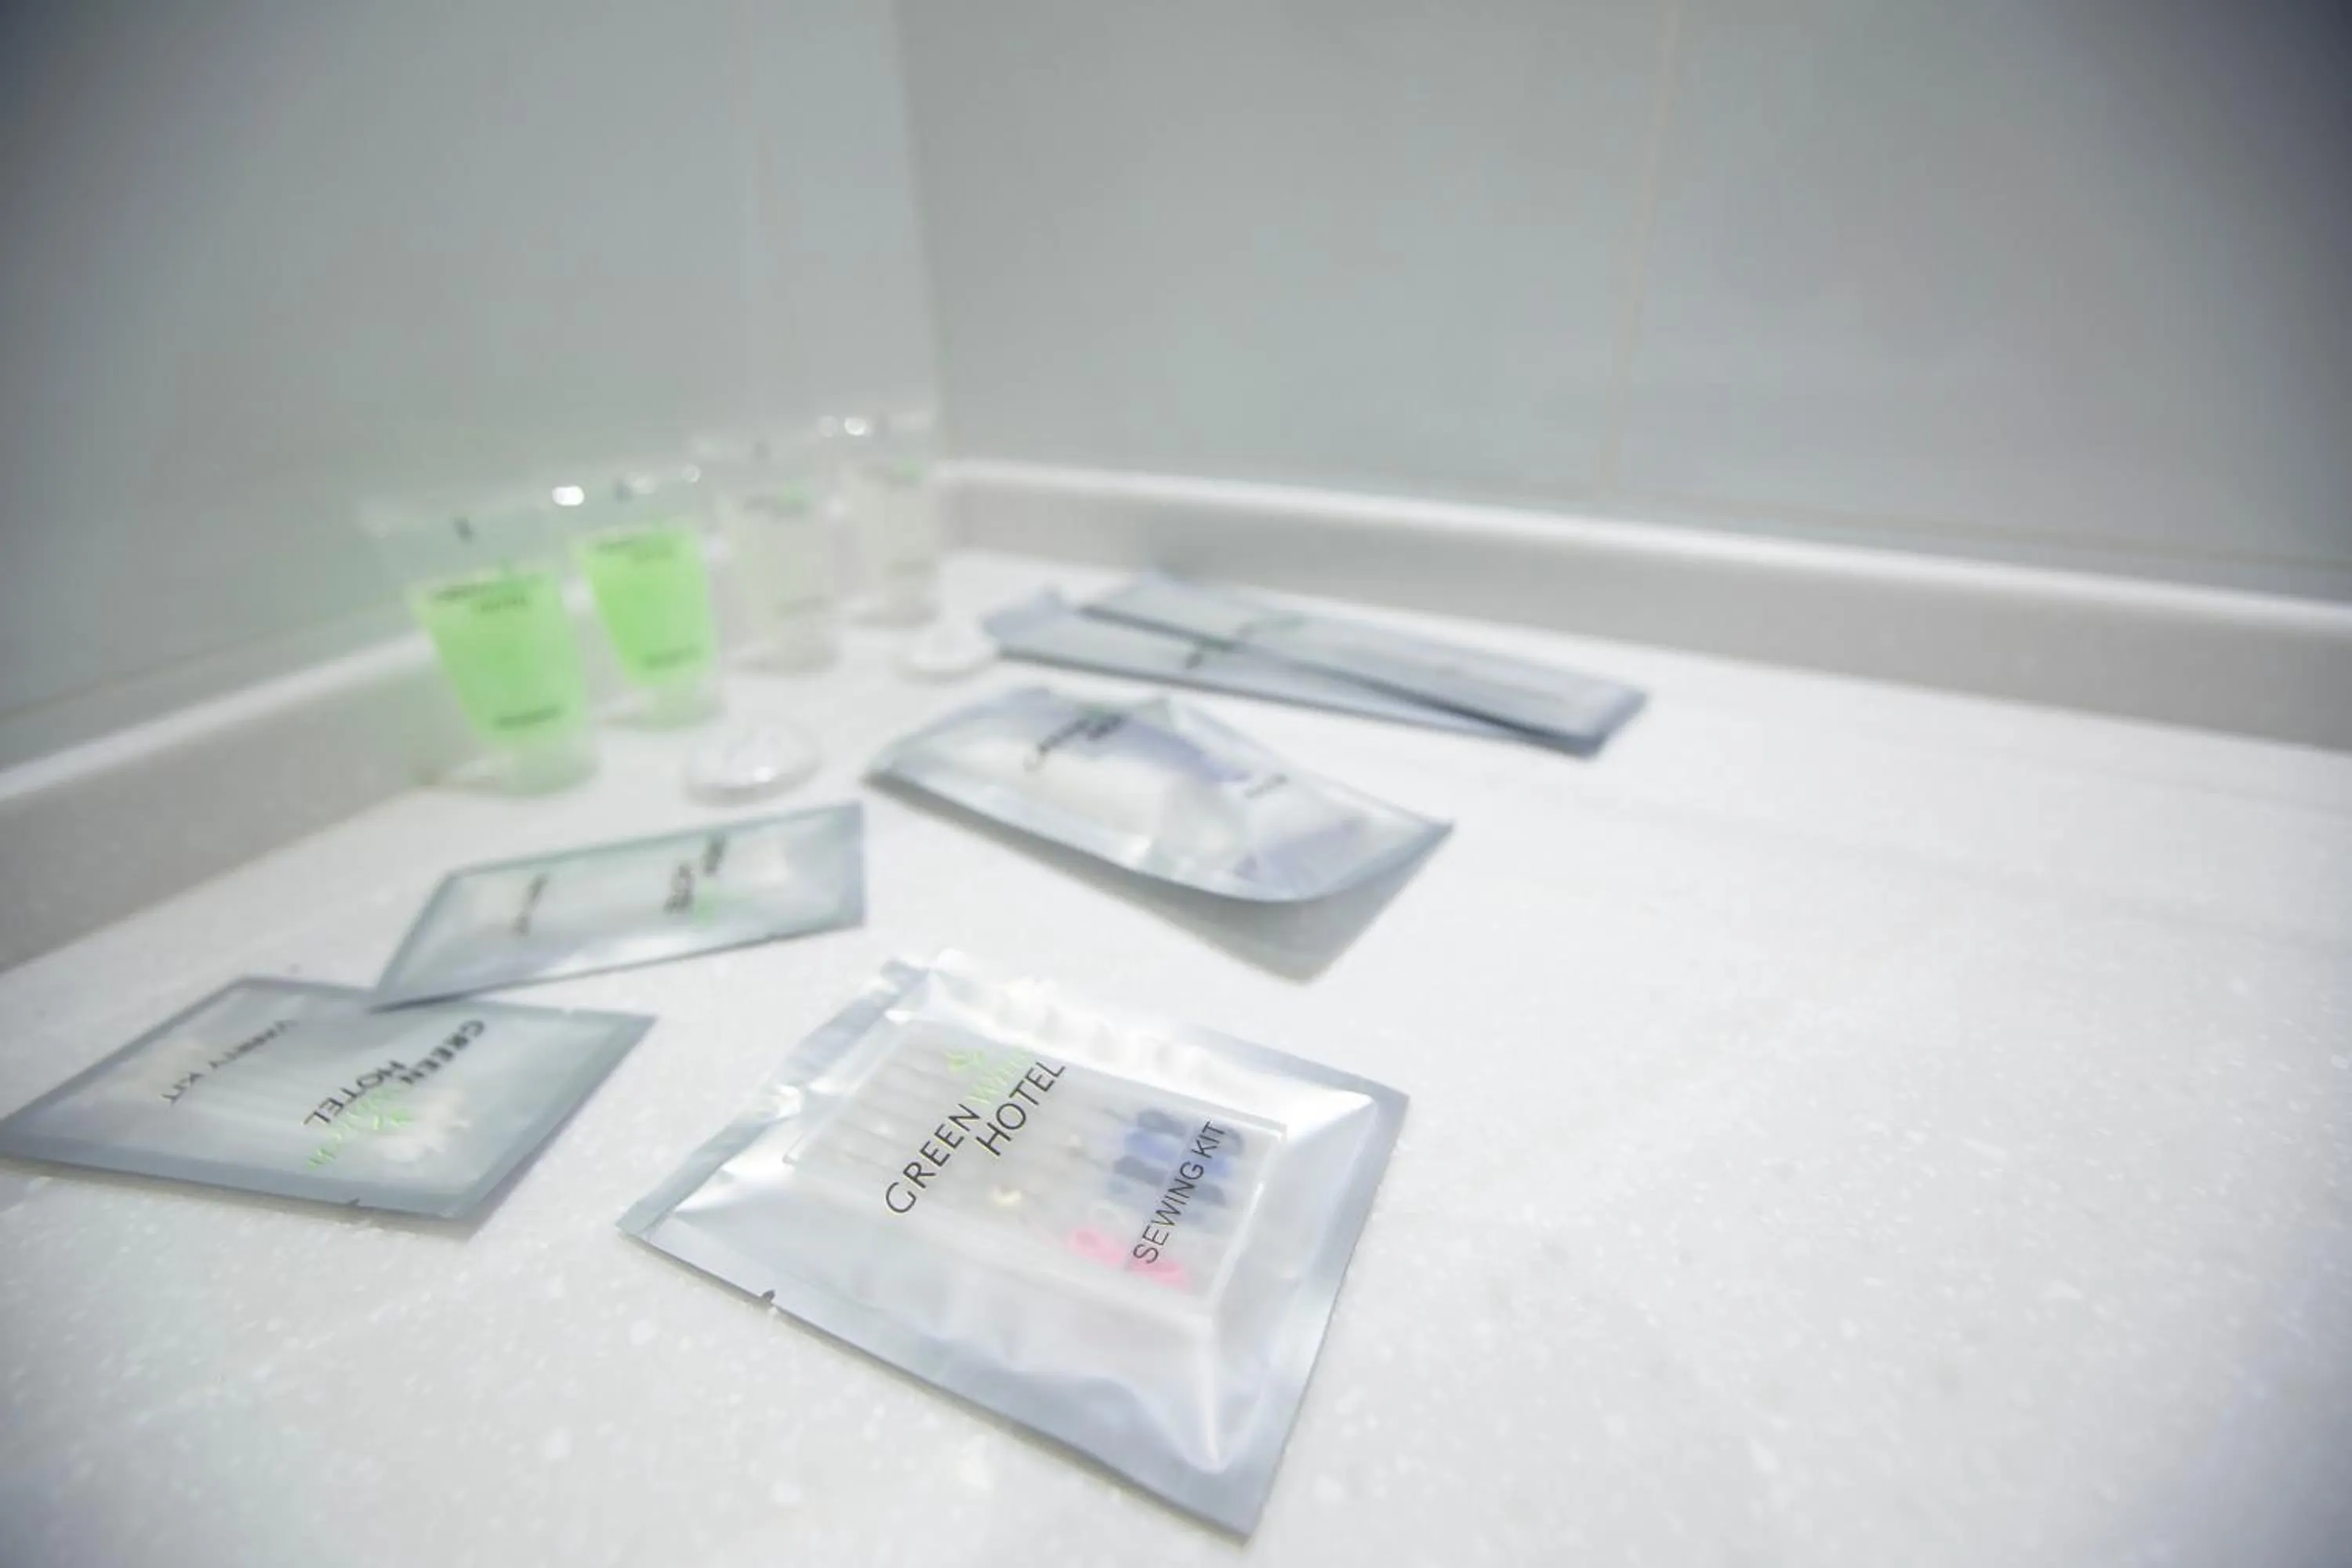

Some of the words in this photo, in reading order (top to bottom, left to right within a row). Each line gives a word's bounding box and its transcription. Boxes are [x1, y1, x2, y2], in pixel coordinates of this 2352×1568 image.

[161, 1073, 206, 1106] KIT
[303, 1059, 406, 1125] HOTEL
[398, 1019, 485, 1085] GREEN
[975, 1061, 1066, 1156] HOTEL
[884, 1103, 982, 1215] GREEN
[1132, 1160, 1204, 1265] SEWING
[1191, 1119, 1226, 1160] KIT
